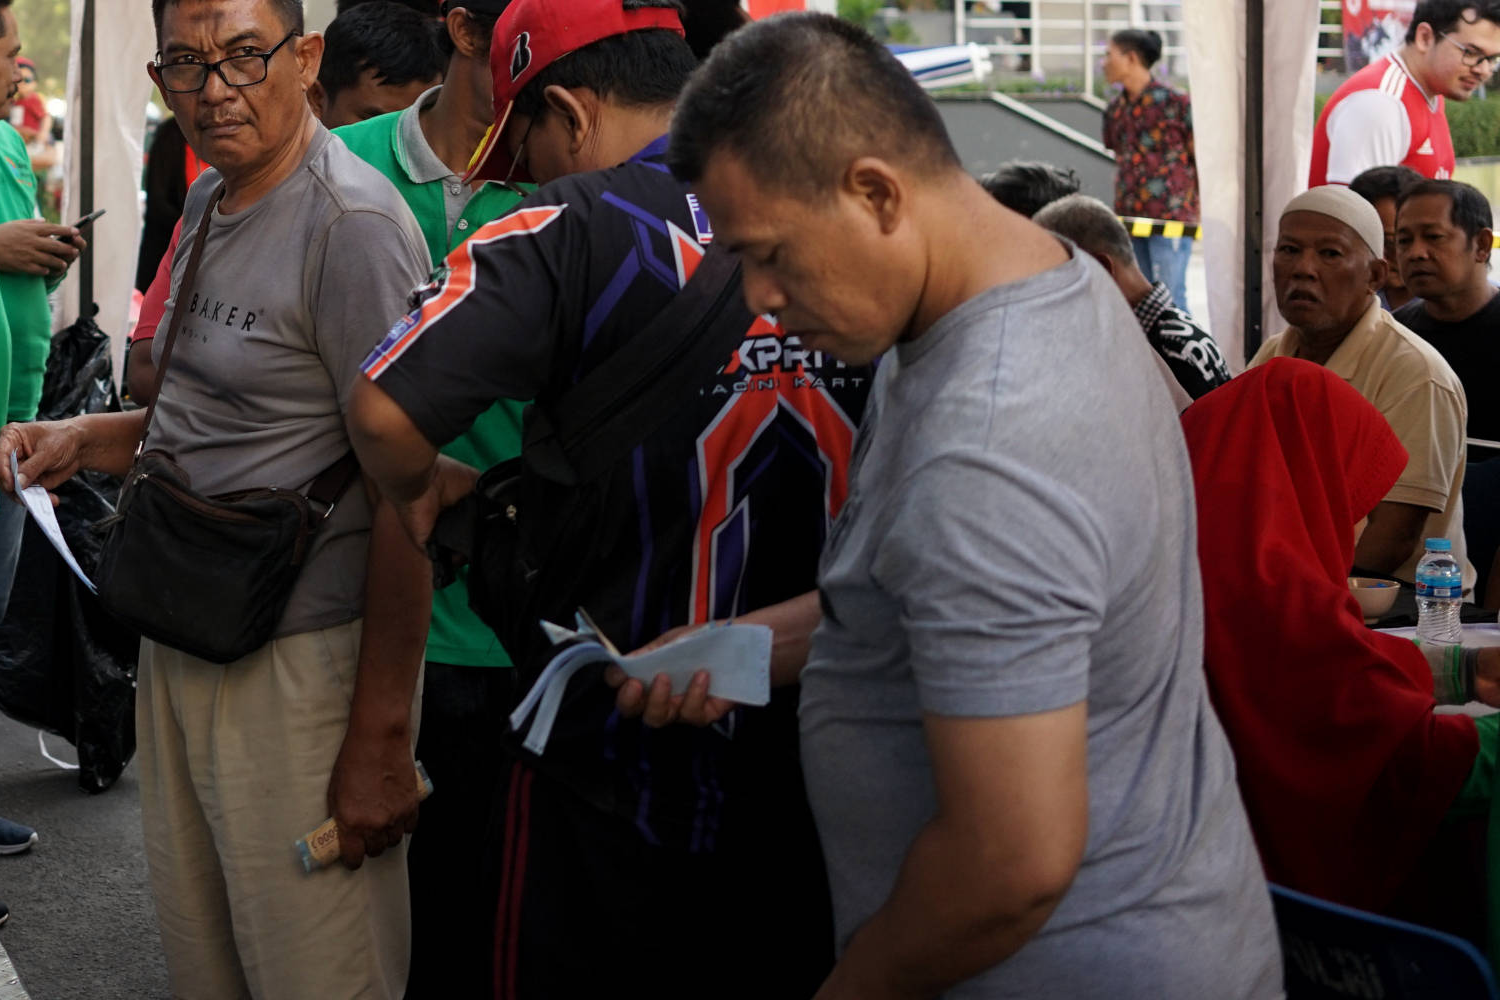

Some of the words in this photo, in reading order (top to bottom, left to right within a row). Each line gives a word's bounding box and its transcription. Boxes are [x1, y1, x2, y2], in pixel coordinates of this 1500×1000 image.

[189, 292, 257, 332] BAKER
[700, 377, 780, 397] ACIN
[794, 376, 864, 391] KART
